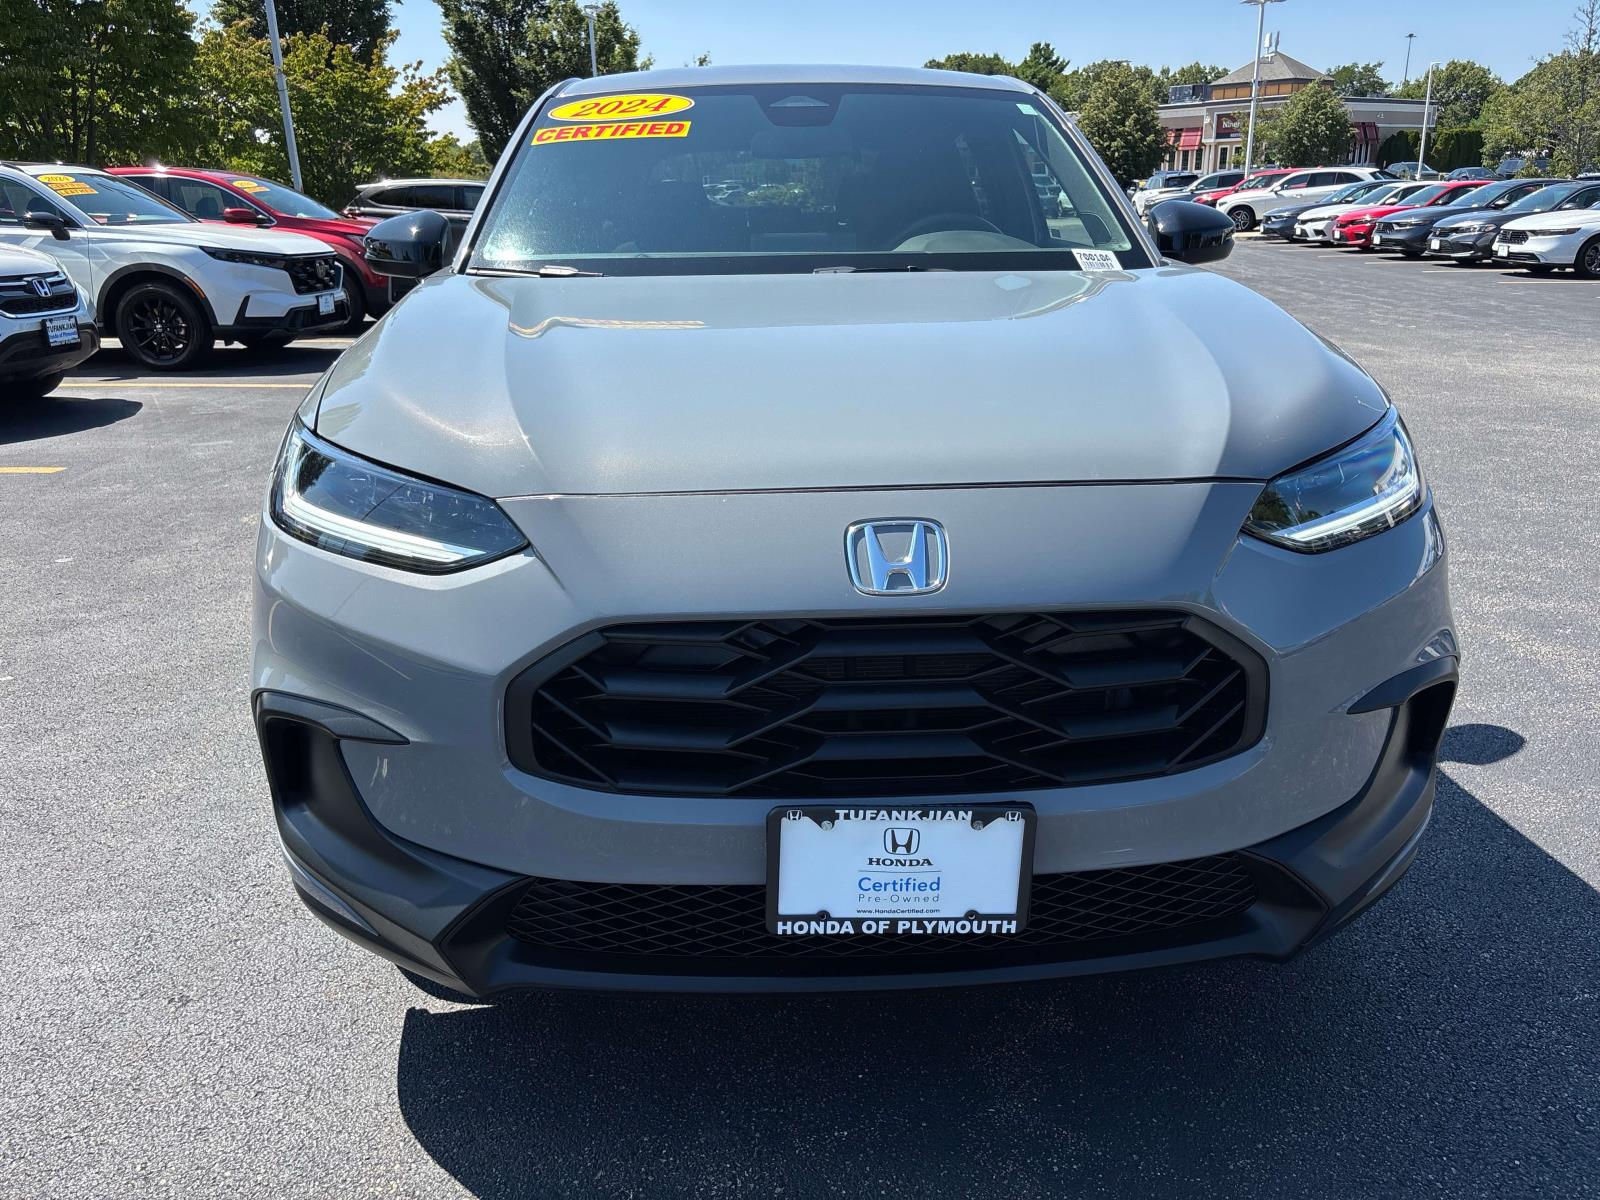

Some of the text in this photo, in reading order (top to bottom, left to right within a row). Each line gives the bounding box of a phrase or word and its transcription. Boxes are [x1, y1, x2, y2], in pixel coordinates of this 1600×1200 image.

[570, 97, 672, 118] 2024
[535, 123, 686, 142] CERTIFIED
[834, 809, 973, 821] TUFANKJIAN
[867, 858, 933, 867] HONDA
[858, 876, 941, 892] Certified
[858, 893, 940, 903] Pre-Owned
[777, 920, 1018, 935] HONDA OF PLYMOUTH
